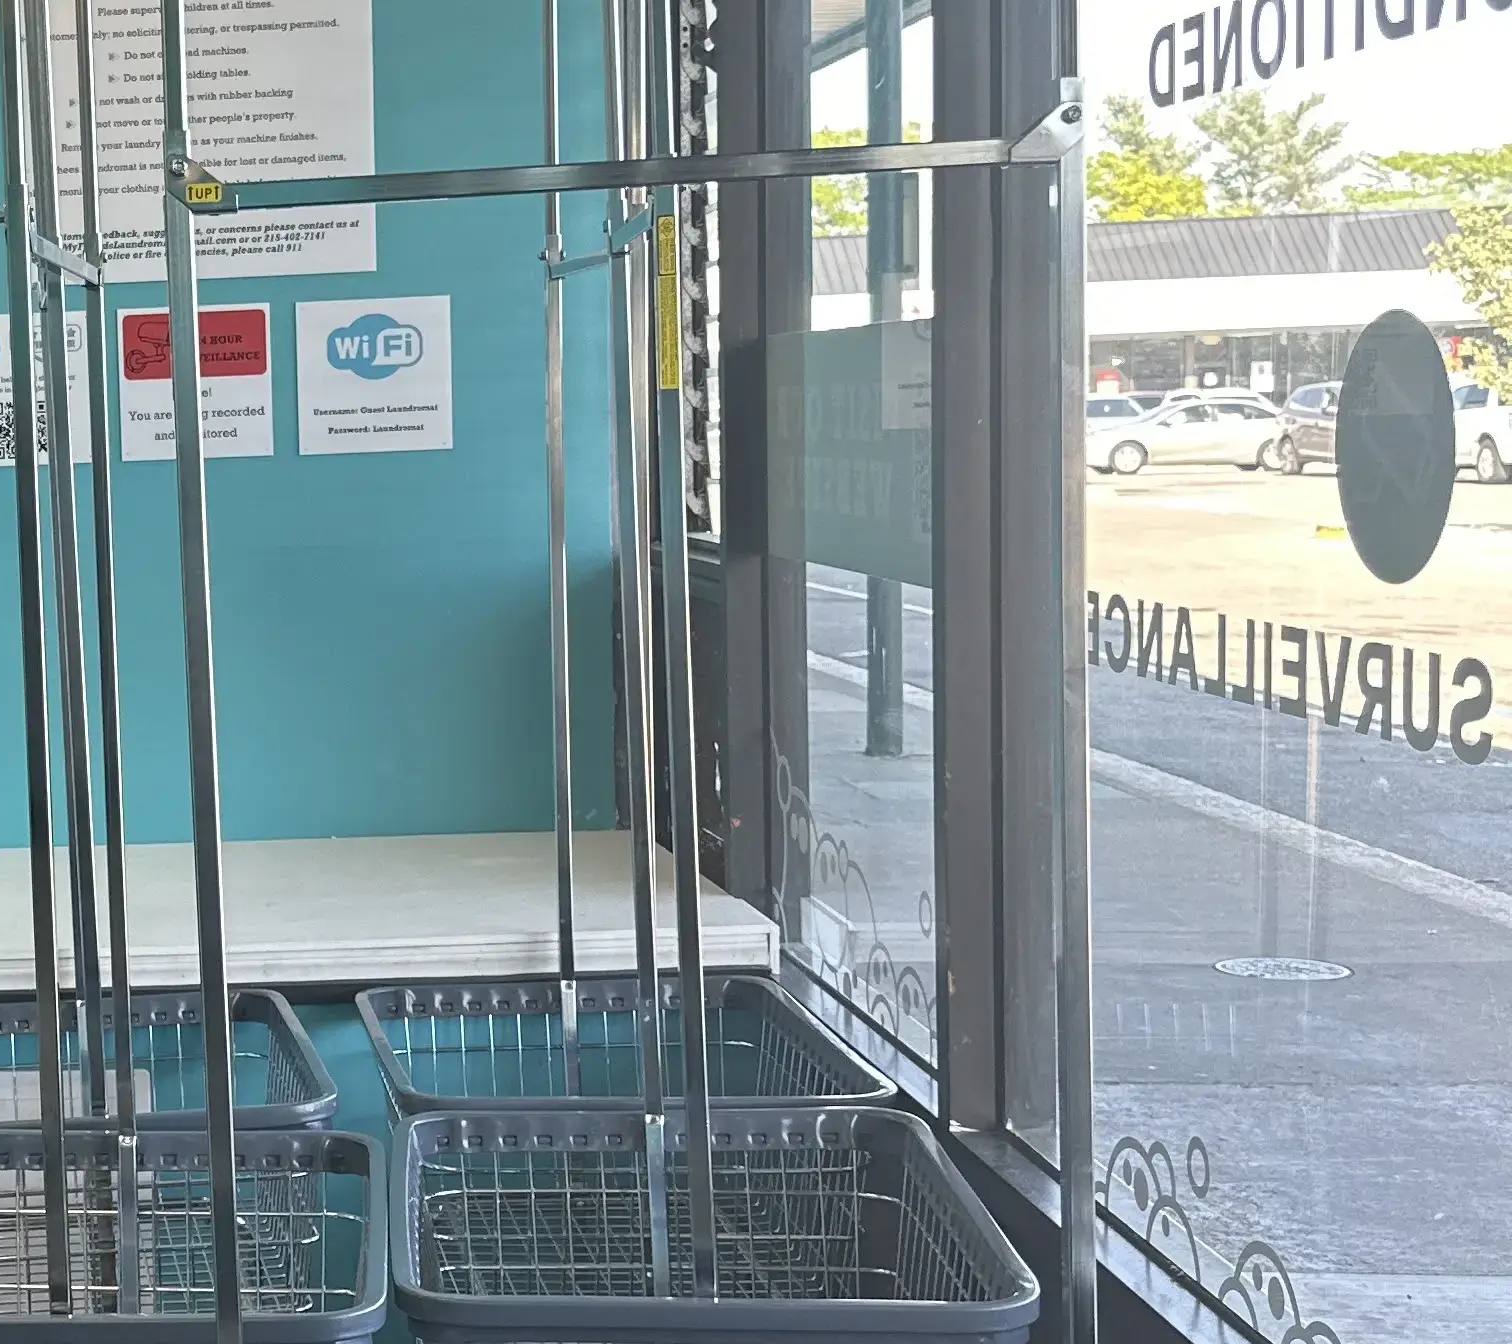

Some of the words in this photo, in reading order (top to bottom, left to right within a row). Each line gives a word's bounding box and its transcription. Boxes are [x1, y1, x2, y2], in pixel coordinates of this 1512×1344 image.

[97, 8, 128, 17] Please
[184, 1, 219, 13] hildren
[221, 1, 229, 10] at
[231, 0, 244, 9] all
[127, 27, 164, 38] solicitin
[220, 24, 230, 33] or
[232, 21, 288, 33] trespassing
[124, 51, 138, 60] Do
[140, 51, 155, 59] not
[123, 73, 138, 82] Do
[139, 73, 154, 81] not
[99, 97, 114, 106] not
[115, 95, 140, 105] wash
[142, 96, 152, 104] or
[197, 92, 217, 101] with
[219, 90, 253, 100] rubber
[254, 88, 293, 100] backing
[96, 120, 111, 129] not
[113, 120, 140, 128] move
[141, 118, 152, 126] or
[188, 114, 207, 124] ther
[101, 142, 123, 153] your
[125, 140, 162, 151] laundry
[200, 138, 211, 146] as
[213, 137, 234, 147] your
[237, 133, 276, 144] machine
[98, 163, 137, 173] ndromat
[139, 162, 147, 171] is
[224, 158, 237, 167] for
[239, 157, 256, 166] lost
[259, 157, 268, 165] or
[270, 154, 316, 166] damaged
[98, 187, 119, 197] your
[121, 184, 160, 195] clothing
[195, 187, 212, 200] UP
[103, 229, 140, 239] edback,
[205, 227, 216, 235] or
[218, 225, 262, 235] concerns
[264, 223, 296, 233] please
[298, 220, 334, 230] contact
[349, 219, 360, 228] at
[239, 236, 249, 244] or
[251, 235, 262, 243] or
[107, 251, 131, 260] olice
[144, 249, 161, 259] fire
[231, 245, 263, 257] please
[265, 243, 284, 253] call
[286, 242, 302, 252] 911
[209, 334, 243, 345] HOUR
[128, 411, 151, 421] You
[154, 412, 172, 420] are
[211, 406, 265, 418] recorded
[360, 406, 385, 414] Guest
[154, 430, 175, 441] and
[203, 427, 238, 439] itored
